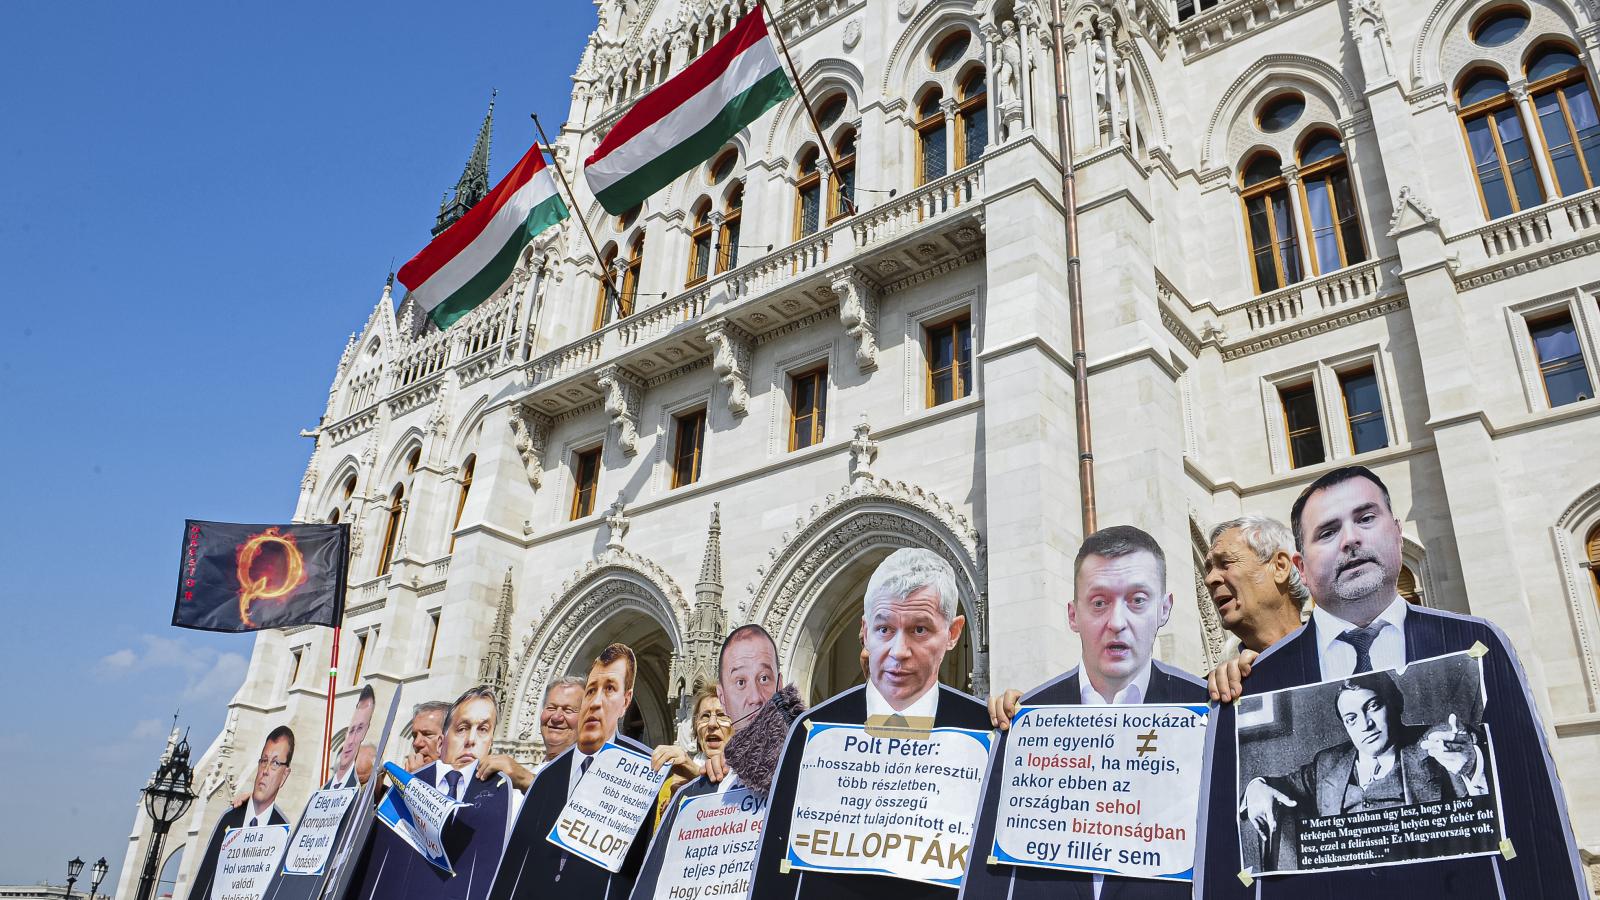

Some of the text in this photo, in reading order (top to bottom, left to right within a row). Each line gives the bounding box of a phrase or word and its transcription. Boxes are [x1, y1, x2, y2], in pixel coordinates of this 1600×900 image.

[237, 527, 305, 627] Q
[1021, 713, 1196, 728] A befektetési kockázat
[844, 735, 941, 757] Polt Péter:
[1018, 733, 1115, 751] nem egyenlő
[616, 757, 640, 776] Polt
[884, 761, 911, 774] időn
[915, 762, 981, 782] keresztül,
[1015, 753, 1180, 774] a lopással, ha mégis,
[603, 785, 620, 798] több
[632, 783, 648, 796] időn
[837, 776, 940, 795] több részletben,
[1012, 774, 1131, 792] akkor ebben az
[315, 796, 330, 812] Elég
[405, 782, 443, 819] A PÉNZÜNKET A
[599, 800, 617, 815] nagy
[840, 796, 928, 811] nagy összegű
[1009, 795, 1141, 815] országban sehol
[568, 800, 607, 823] készpénzt
[796, 807, 861, 825] készpénzt
[863, 812, 944, 831] tulajdonított
[1310, 818, 1332, 828] Mert
[1333, 817, 1346, 827] így
[1347, 812, 1381, 823] valóban
[1383, 810, 1399, 820] úgy
[1401, 807, 1419, 817] lesz,
[1420, 804, 1443, 815] hogy
[1452, 799, 1473, 812] jövő
[677, 818, 747, 841] kamatokkal
[1006, 814, 1186, 842] nincsen biztonságban
[1300, 809, 1494, 842] térképén Magyarország helyén egy fehér folt
[244, 832, 264, 843] Hol a
[299, 834, 314, 851] Elég
[1301, 843, 1319, 854] lesz,
[1320, 841, 1339, 851] ezzel
[1348, 836, 1390, 848] felírással:
[1391, 834, 1403, 844] Ez
[1405, 826, 1471, 842] Magyarország
[1472, 823, 1494, 834] volt,
[227, 846, 276, 859] 210 Milliárd?
[685, 845, 718, 862] kapta
[795, 829, 971, 870] =ELLOPTÁK
[1026, 841, 1161, 866] egy fillér sem
[223, 862, 271, 874] Hol vannak a
[1302, 856, 1313, 865] de
[683, 863, 715, 881] teljes
[232, 878, 255, 889] valódi
[669, 885, 701, 900] Hogy
